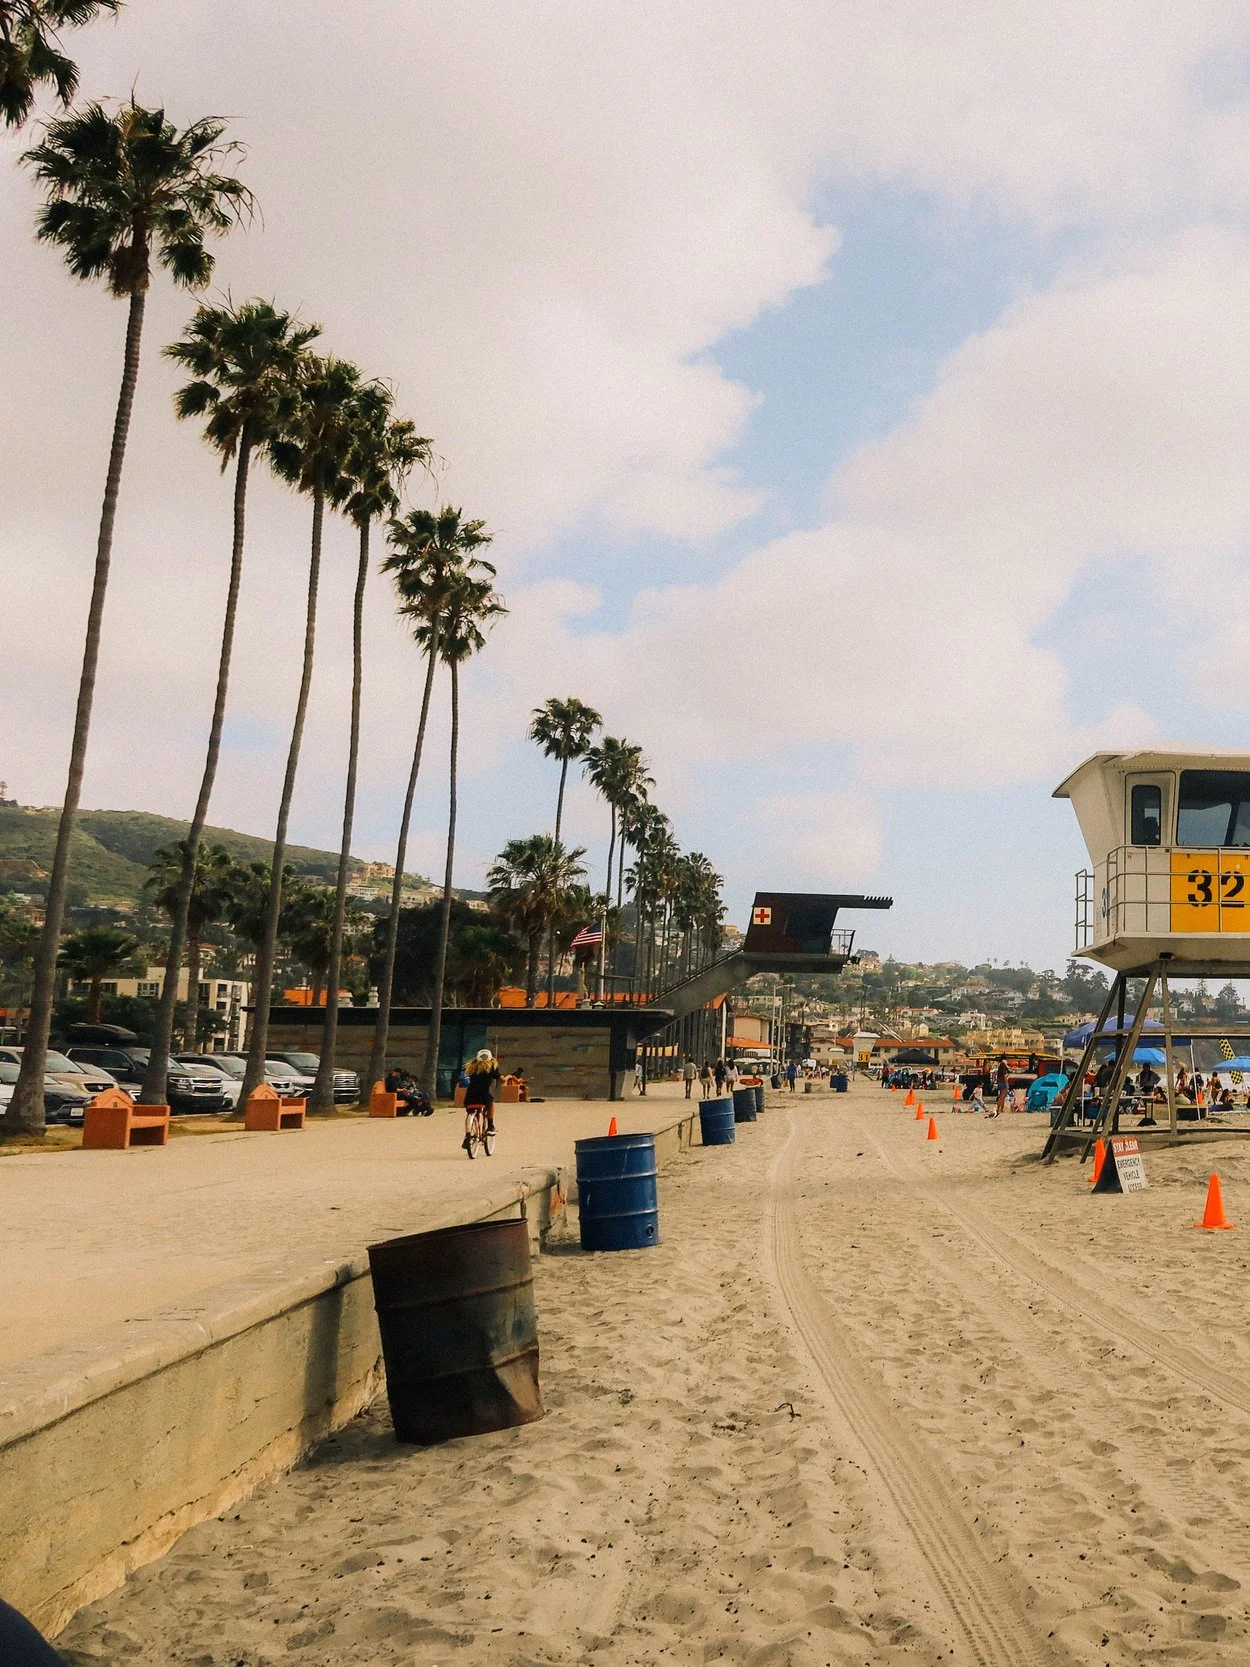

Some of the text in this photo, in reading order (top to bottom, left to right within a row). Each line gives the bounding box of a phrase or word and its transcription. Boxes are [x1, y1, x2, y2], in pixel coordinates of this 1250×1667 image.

[1187, 869, 1245, 908] 32
[858, 1053, 869, 1061] 31
[1113, 1141, 1124, 1153] STAY
[1117, 1158, 1140, 1169] EMERGENCY
[1123, 1170, 1140, 1181] VEHICLE
